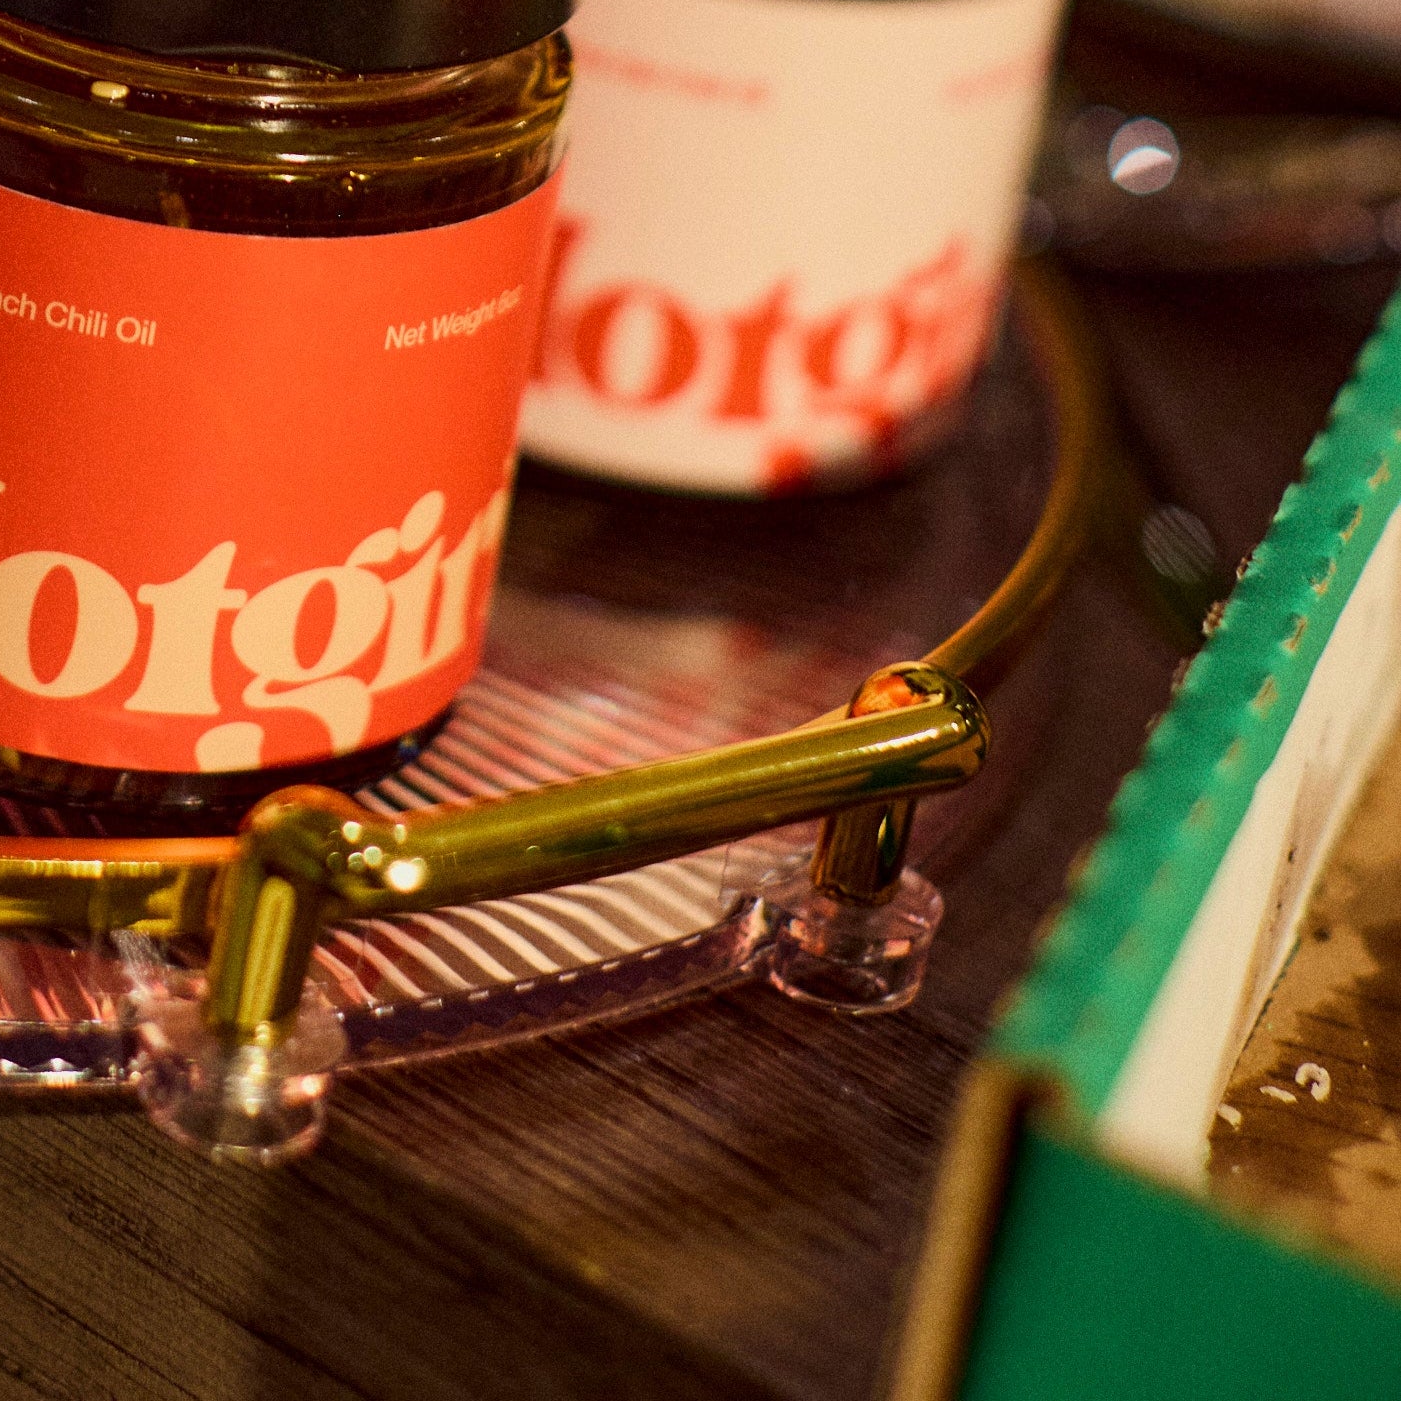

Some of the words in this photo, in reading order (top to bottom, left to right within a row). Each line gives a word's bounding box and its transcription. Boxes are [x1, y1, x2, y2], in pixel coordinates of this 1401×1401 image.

[44, 300, 109, 339] Chili
[115, 315, 158, 347] Oil
[384, 320, 428, 350] Net
[432, 297, 497, 342] Weight
